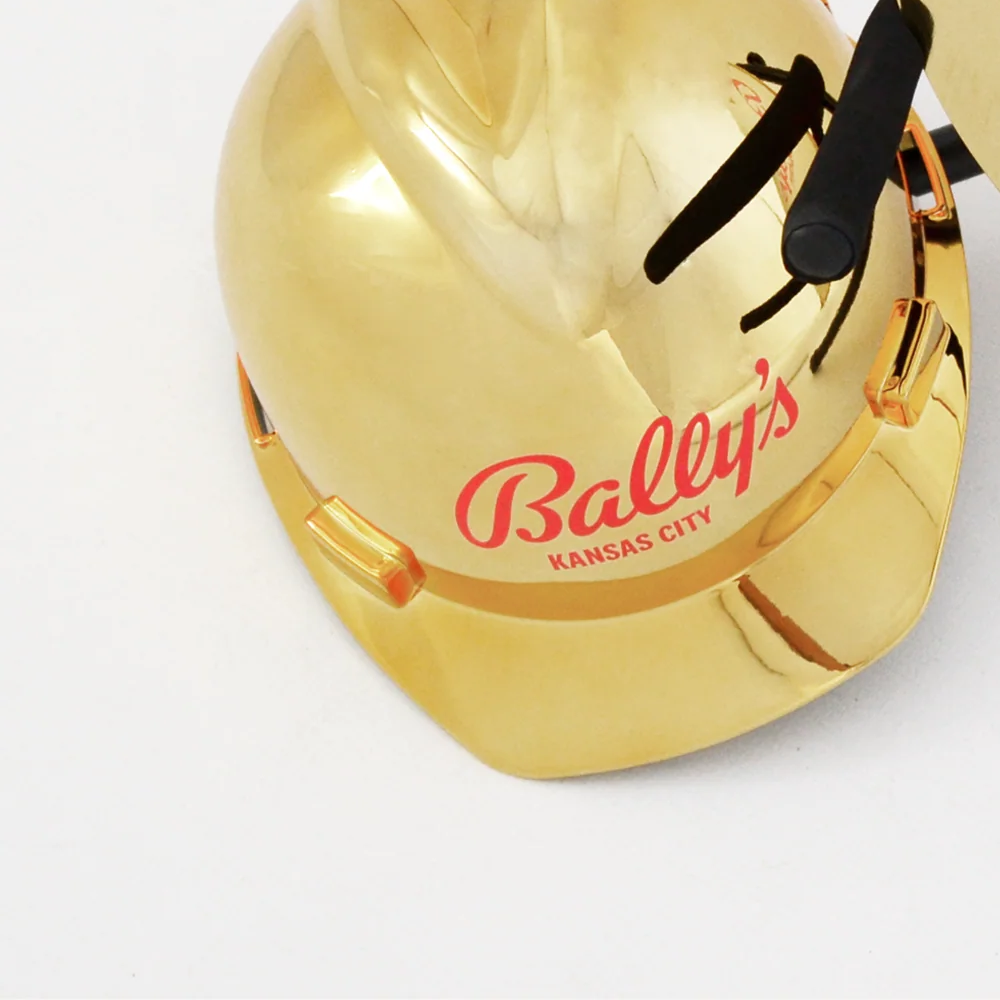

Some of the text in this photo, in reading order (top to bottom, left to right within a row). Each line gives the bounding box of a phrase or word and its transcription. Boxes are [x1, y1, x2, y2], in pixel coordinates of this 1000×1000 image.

[455, 358, 799, 549] Bally's
[547, 504, 712, 571] KANSAS CITY
